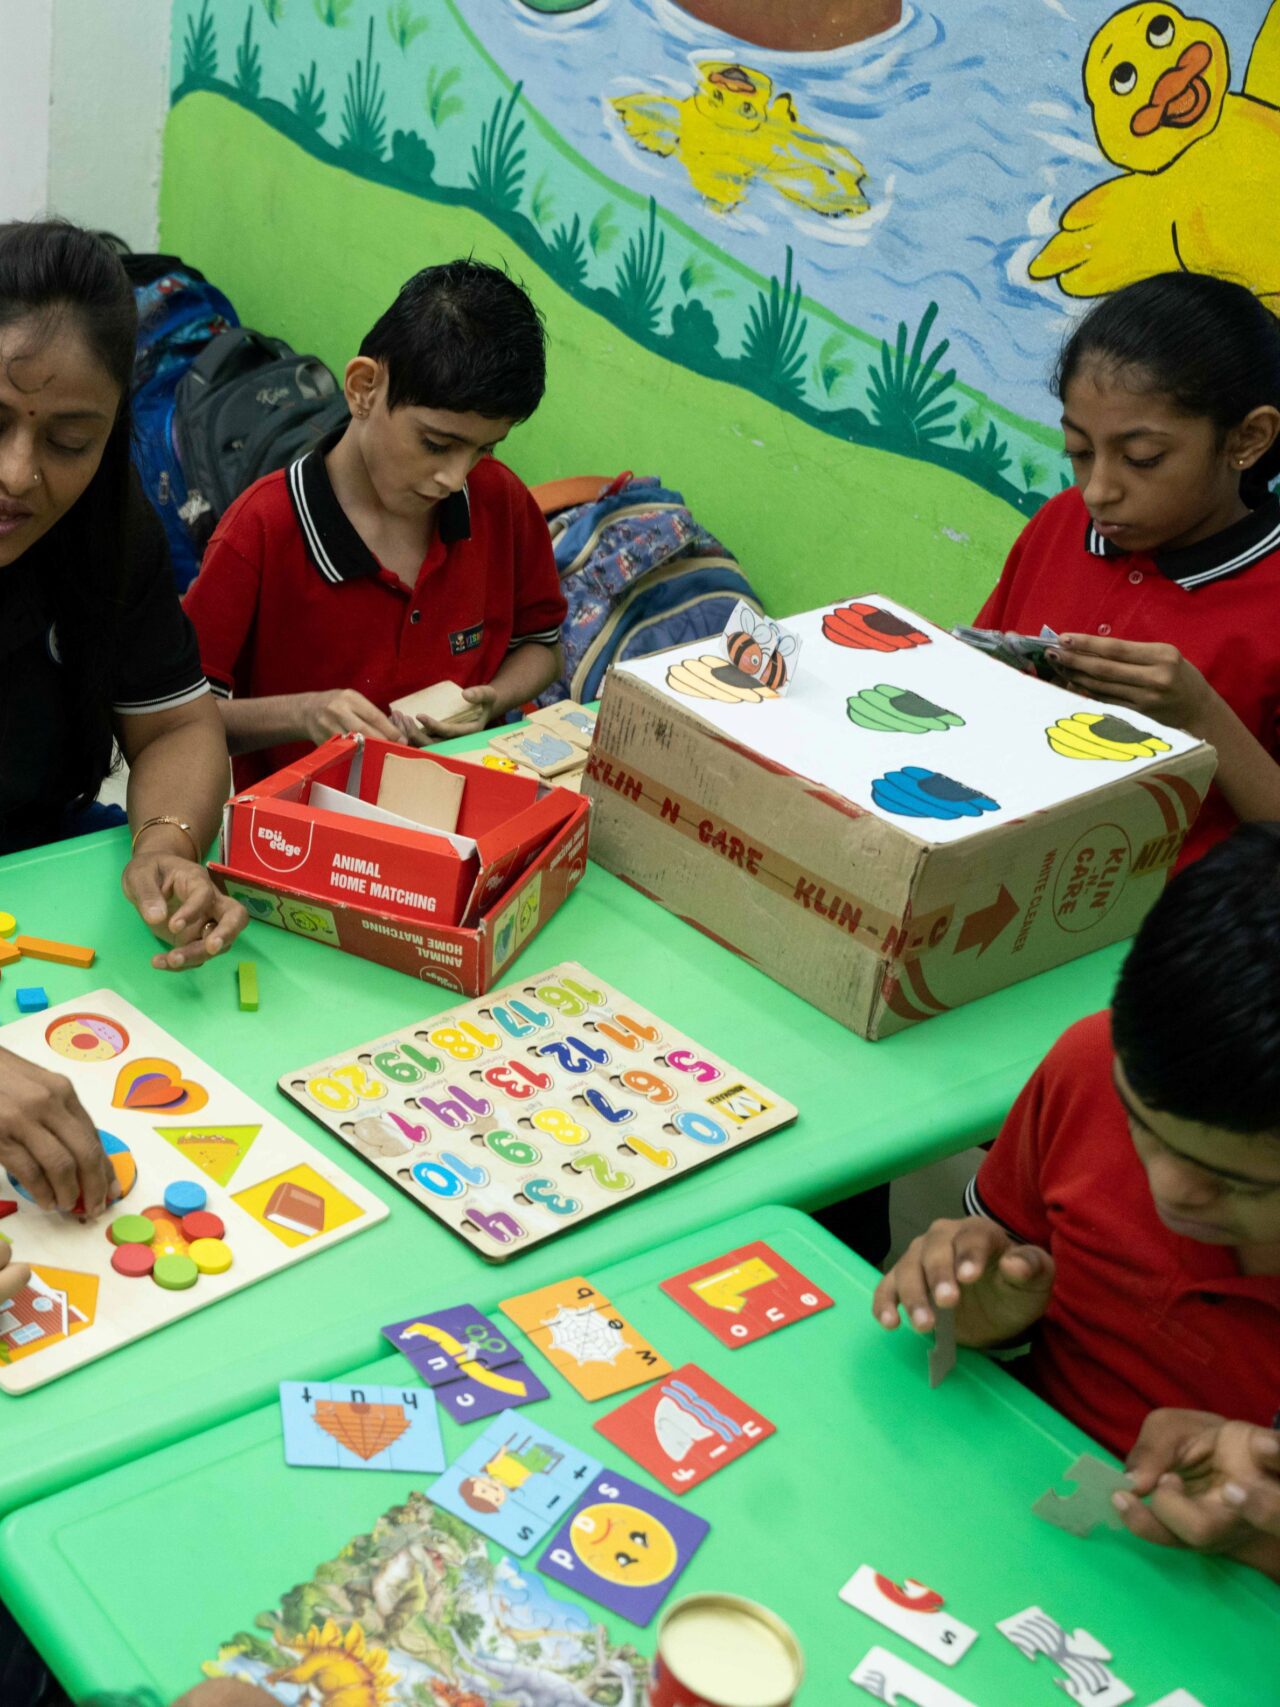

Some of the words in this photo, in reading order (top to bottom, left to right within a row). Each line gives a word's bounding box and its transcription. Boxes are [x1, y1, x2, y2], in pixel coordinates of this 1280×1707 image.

[586, 754, 643, 802] KLIN
[660, 797, 680, 824] N
[699, 820, 763, 875] CARE
[269, 839, 301, 857] edge
[332, 853, 381, 878] ANIMAL
[1034, 849, 1057, 893] WHITE
[1058, 848, 1095, 917] CARE
[1090, 848, 1129, 910] KLIN
[330, 872, 366, 894] HOME
[370, 882, 437, 912] MATCHING
[793, 877, 863, 934] KLIN
[362, 920, 423, 945] MATCHING
[428, 938, 462, 955] HOME
[416, 946, 462, 967] ANIMAL
[536, 978, 605, 1016] 16
[492, 1000, 551, 1038] 17
[595, 1014, 659, 1050] 11
[431, 1020, 499, 1060] 18
[539, 1036, 609, 1073] 12
[374, 1044, 441, 1083] 19
[485, 1060, 551, 1098] 13
[666, 1050, 721, 1083] 5
[308, 1064, 385, 1110] 20
[622, 1071, 676, 1102] 6
[417, 1085, 490, 1128] 14
[585, 1089, 634, 1123] 7
[531, 1109, 589, 1144] 8
[673, 1112, 728, 1145] 0
[486, 1131, 537, 1164] 9
[625, 1135, 673, 1168] 1
[412, 1152, 486, 1197] 10
[572, 1154, 631, 1190] 2
[524, 1179, 578, 1214] 3
[466, 1208, 524, 1243] 4
